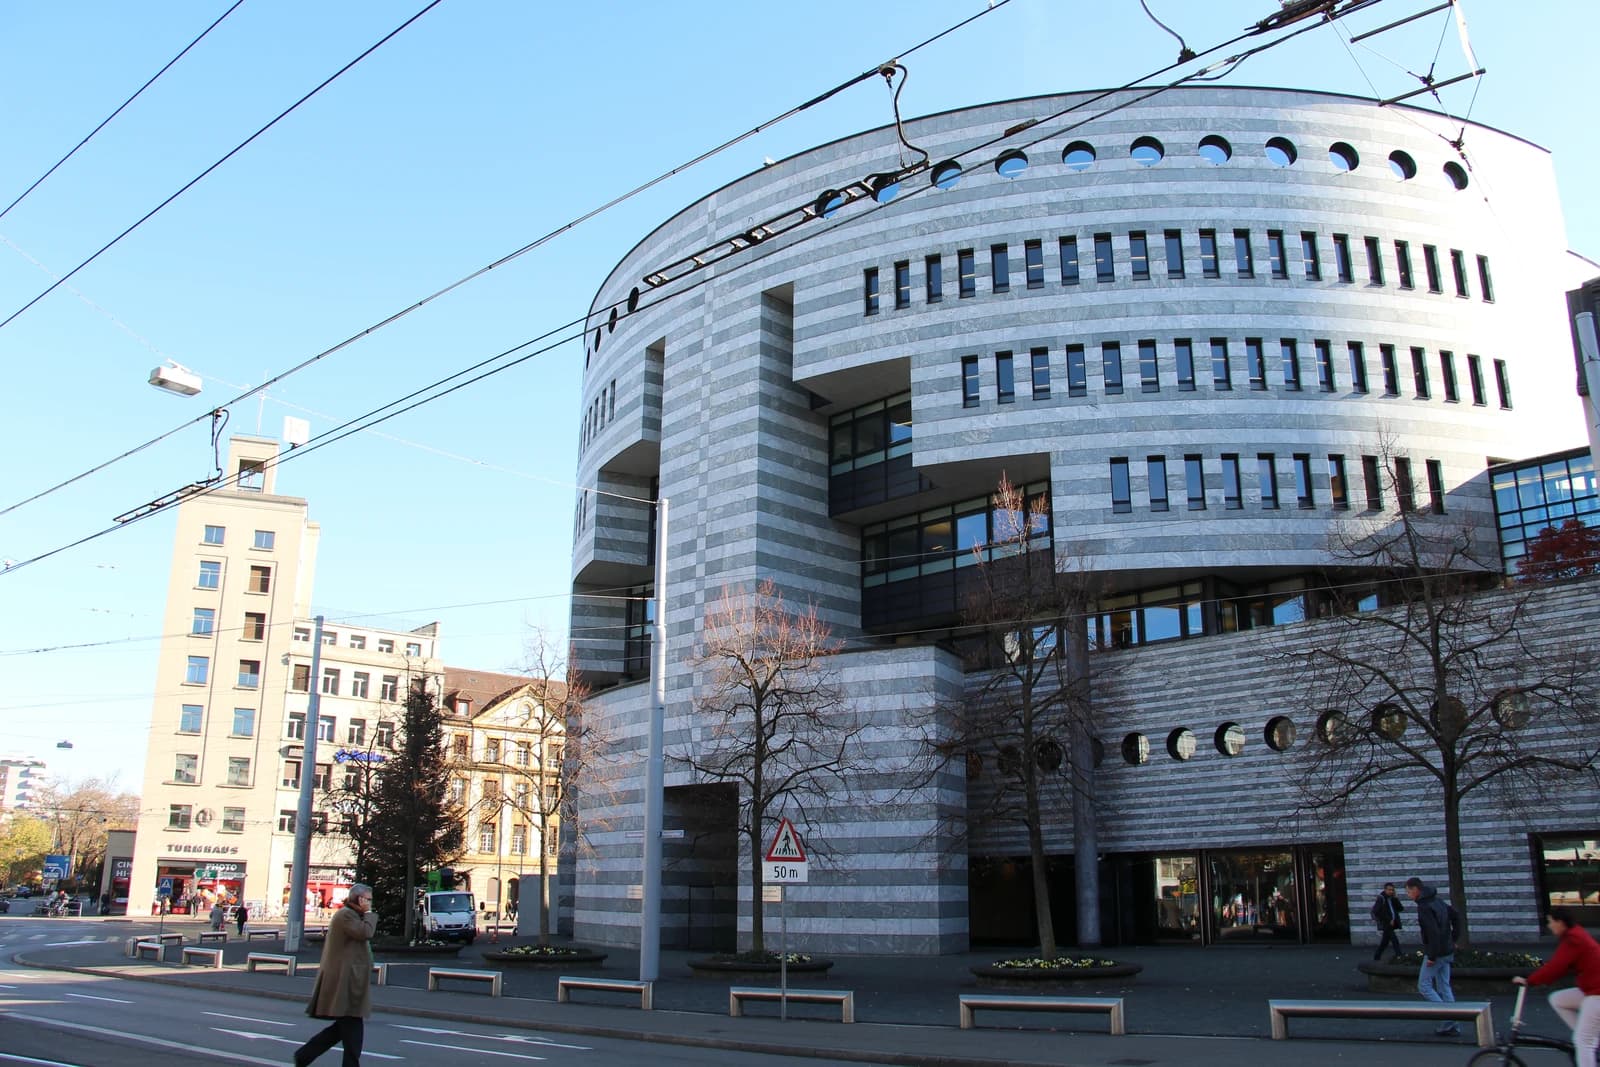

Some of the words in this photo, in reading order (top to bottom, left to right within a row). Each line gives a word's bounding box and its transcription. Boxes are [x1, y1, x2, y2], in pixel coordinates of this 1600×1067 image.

[166, 844, 239, 855] TURMHAUS
[205, 863, 238, 871] PHOTO
[774, 866, 787, 879] 50
[789, 869, 798, 879] m
